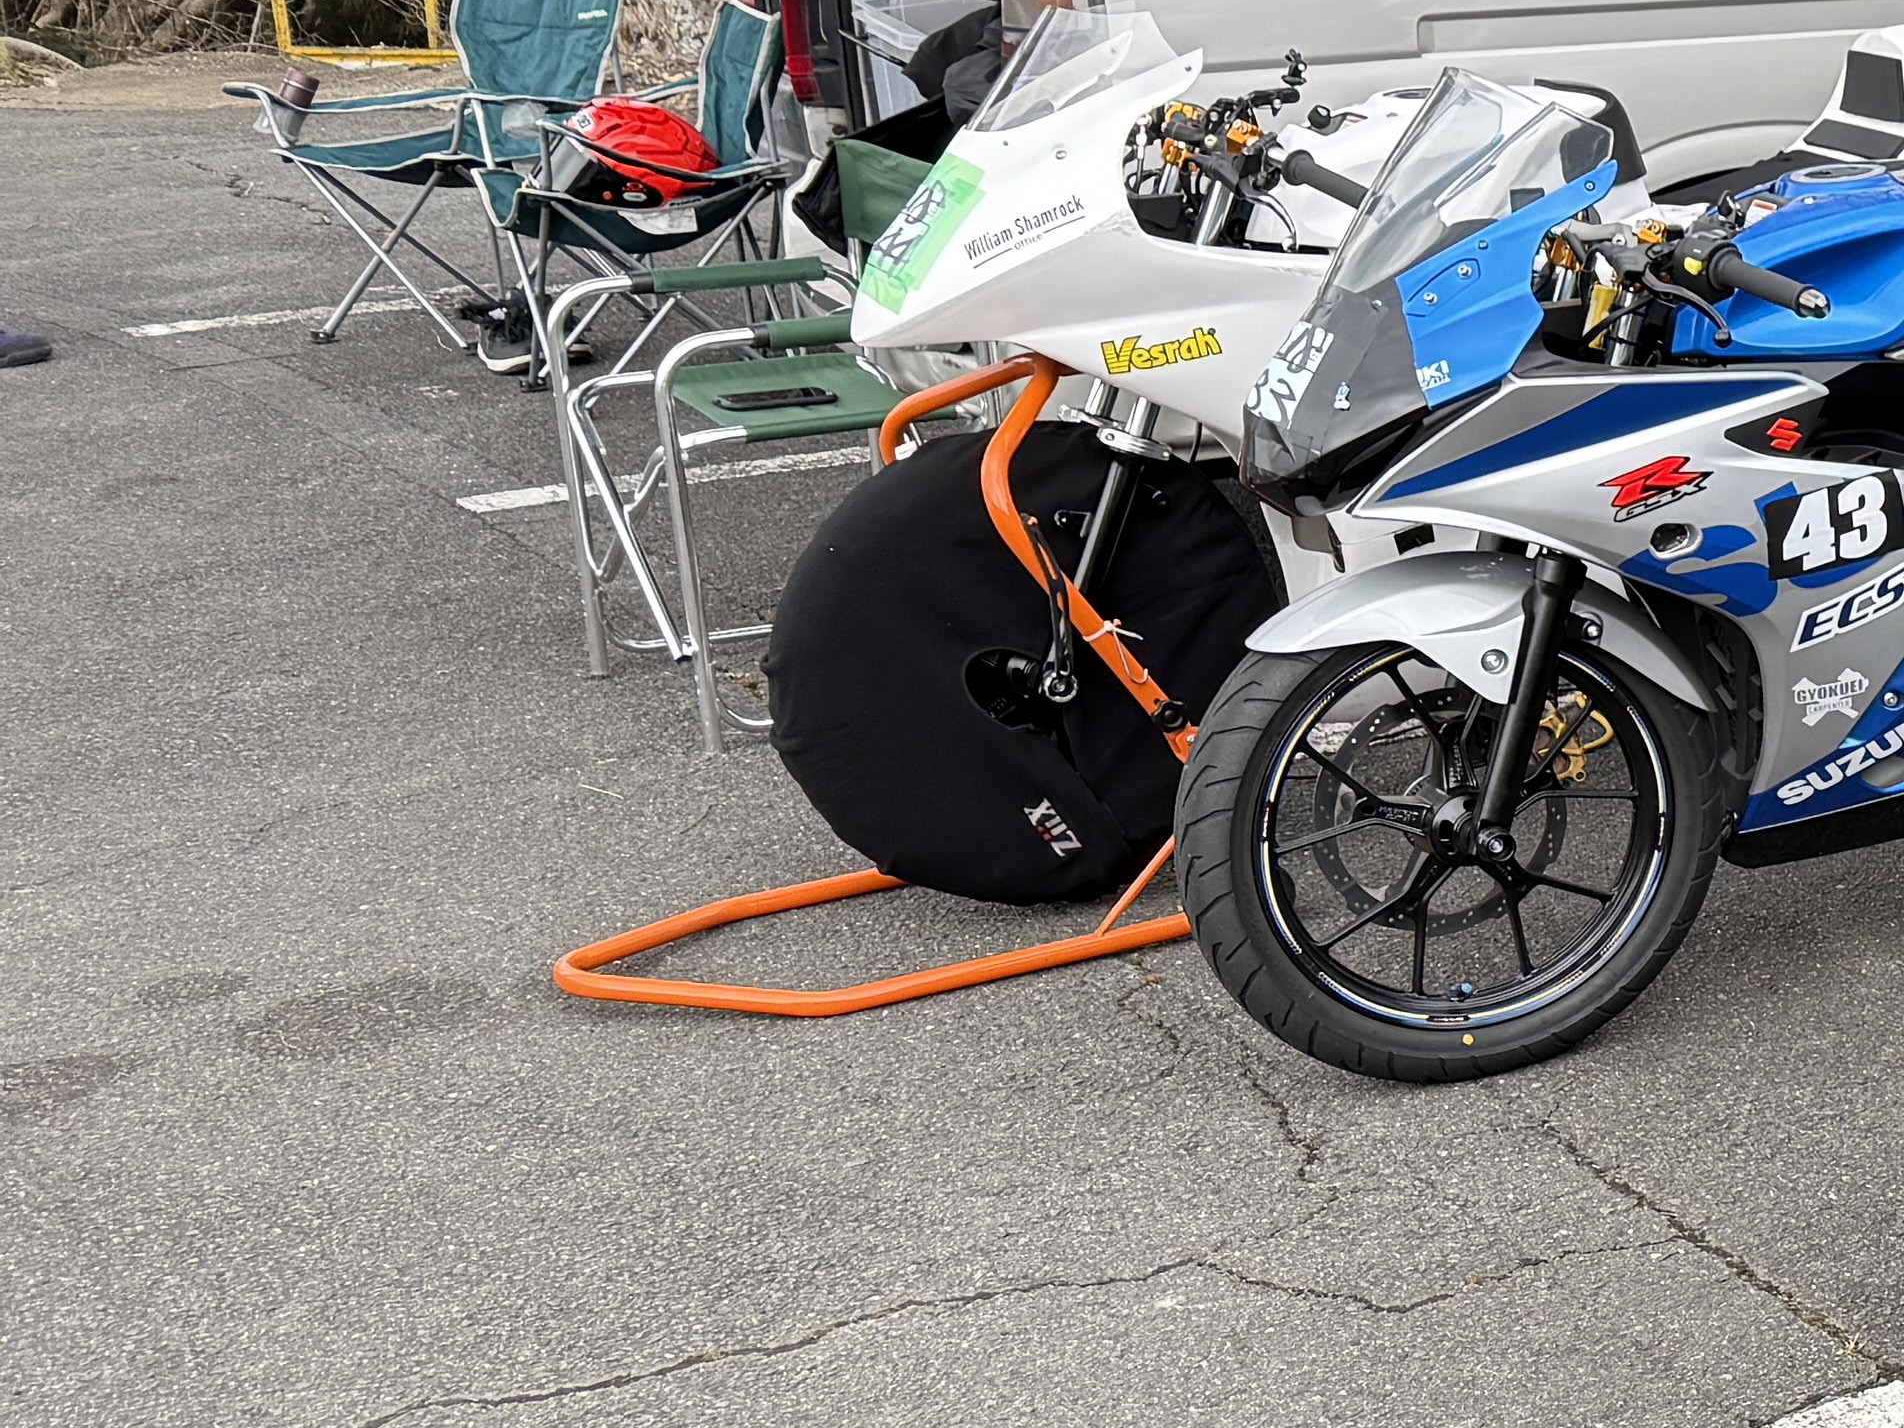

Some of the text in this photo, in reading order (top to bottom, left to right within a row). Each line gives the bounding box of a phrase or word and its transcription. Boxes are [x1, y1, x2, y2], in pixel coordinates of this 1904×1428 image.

[964, 194, 1085, 261] William Shamrock
[1100, 327, 1223, 375] Vesrah
[1782, 475, 1889, 572] 43
[1796, 678, 1866, 705] GYOKUEI
